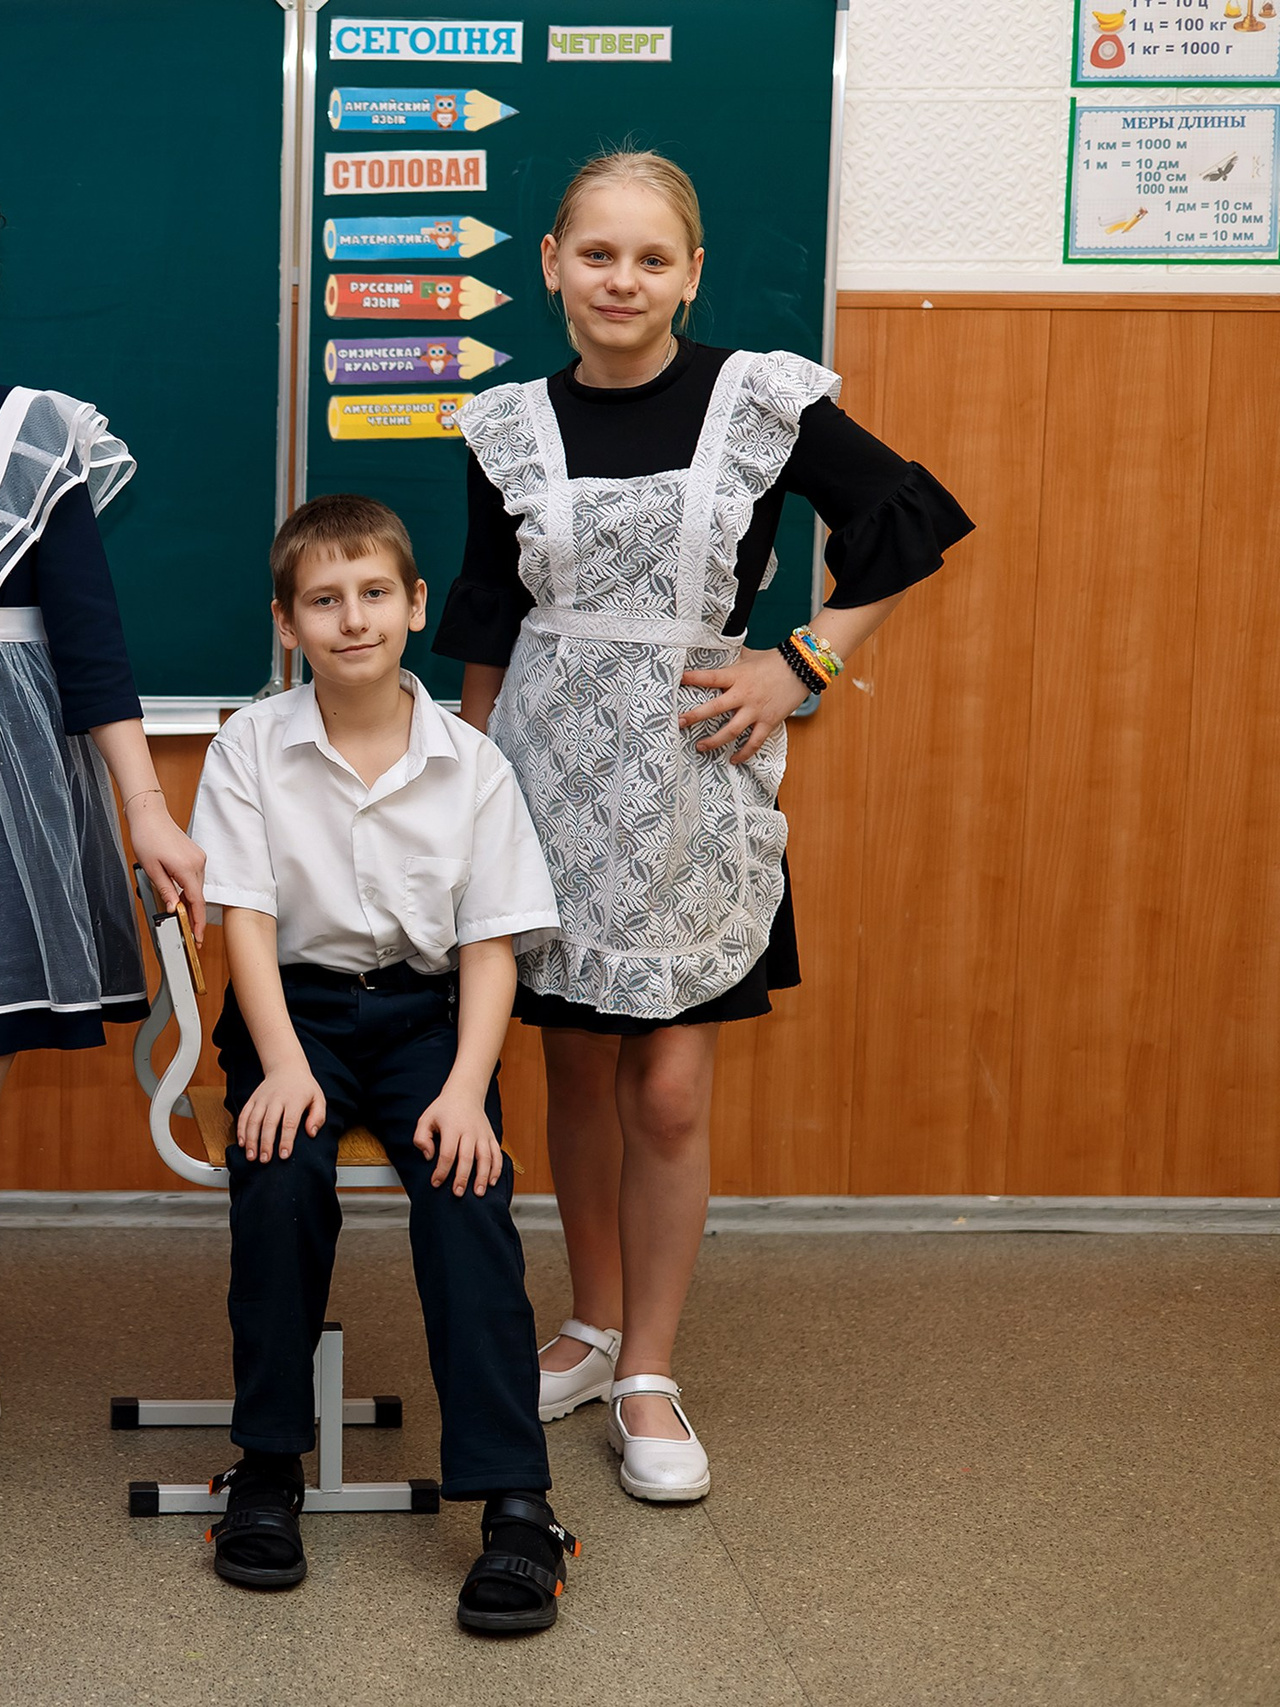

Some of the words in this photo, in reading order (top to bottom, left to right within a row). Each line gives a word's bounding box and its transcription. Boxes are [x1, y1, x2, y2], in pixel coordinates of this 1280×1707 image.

[1129, 18, 1136, 31] 1
[1143, 22, 1154, 33] ц
[1175, 18, 1204, 31] 100
[1209, 21, 1227, 31] кг
[335, 26, 516, 55] СЕГОДНЯ
[550, 33, 665, 54] ЧЕТВЕРГ
[1128, 42, 1135, 55] 1
[1142, 45, 1160, 55] кг
[1180, 41, 1220, 55] 1000
[1225, 45, 1233, 54] г
[344, 99, 431, 112] АНГЛИЙСКИЙ
[371, 115, 406, 125] ЯЗЫК
[1122, 116, 1175, 129] МЕРЫ
[1177, 115, 1247, 131] ДЛИНЫ
[1084, 139, 1091, 150] 1
[1097, 141, 1117, 150] км
[1136, 139, 1171, 149] 1000
[1176, 140, 1188, 149] м
[1083, 159, 1090, 170] 1
[1096, 161, 1108, 170] м
[1136, 158, 1153, 169] 10
[1156, 160, 1180, 171] дм
[332, 157, 480, 189] СТОЛОВАЯ
[1136, 171, 1161, 182] 100
[1166, 173, 1187, 182] см
[1136, 183, 1165, 195] 1000
[1169, 185, 1188, 194] мм
[1165, 200, 1171, 211] 1
[1175, 202, 1196, 213] дм
[1214, 200, 1229, 210] 10
[1233, 202, 1252, 210] см
[1213, 213, 1237, 224] 100
[1242, 214, 1263, 223] мм
[339, 234, 431, 245] МАТЕМАТИКА
[1164, 231, 1171, 242] 1
[1176, 233, 1195, 241] см
[1212, 230, 1228, 241] 10
[1232, 232, 1254, 241] мм
[349, 280, 414, 294] РУССКИЙ
[362, 297, 400, 308] ЯЗЫК
[337, 347, 422, 359] ФИЗИЧЕСКАЯ
[344, 361, 414, 372] КУЛЬТУРА
[343, 403, 435, 414] ЛИТЕРАТУРНОЕ
[366, 416, 412, 426] ЧТЕНИЕ
